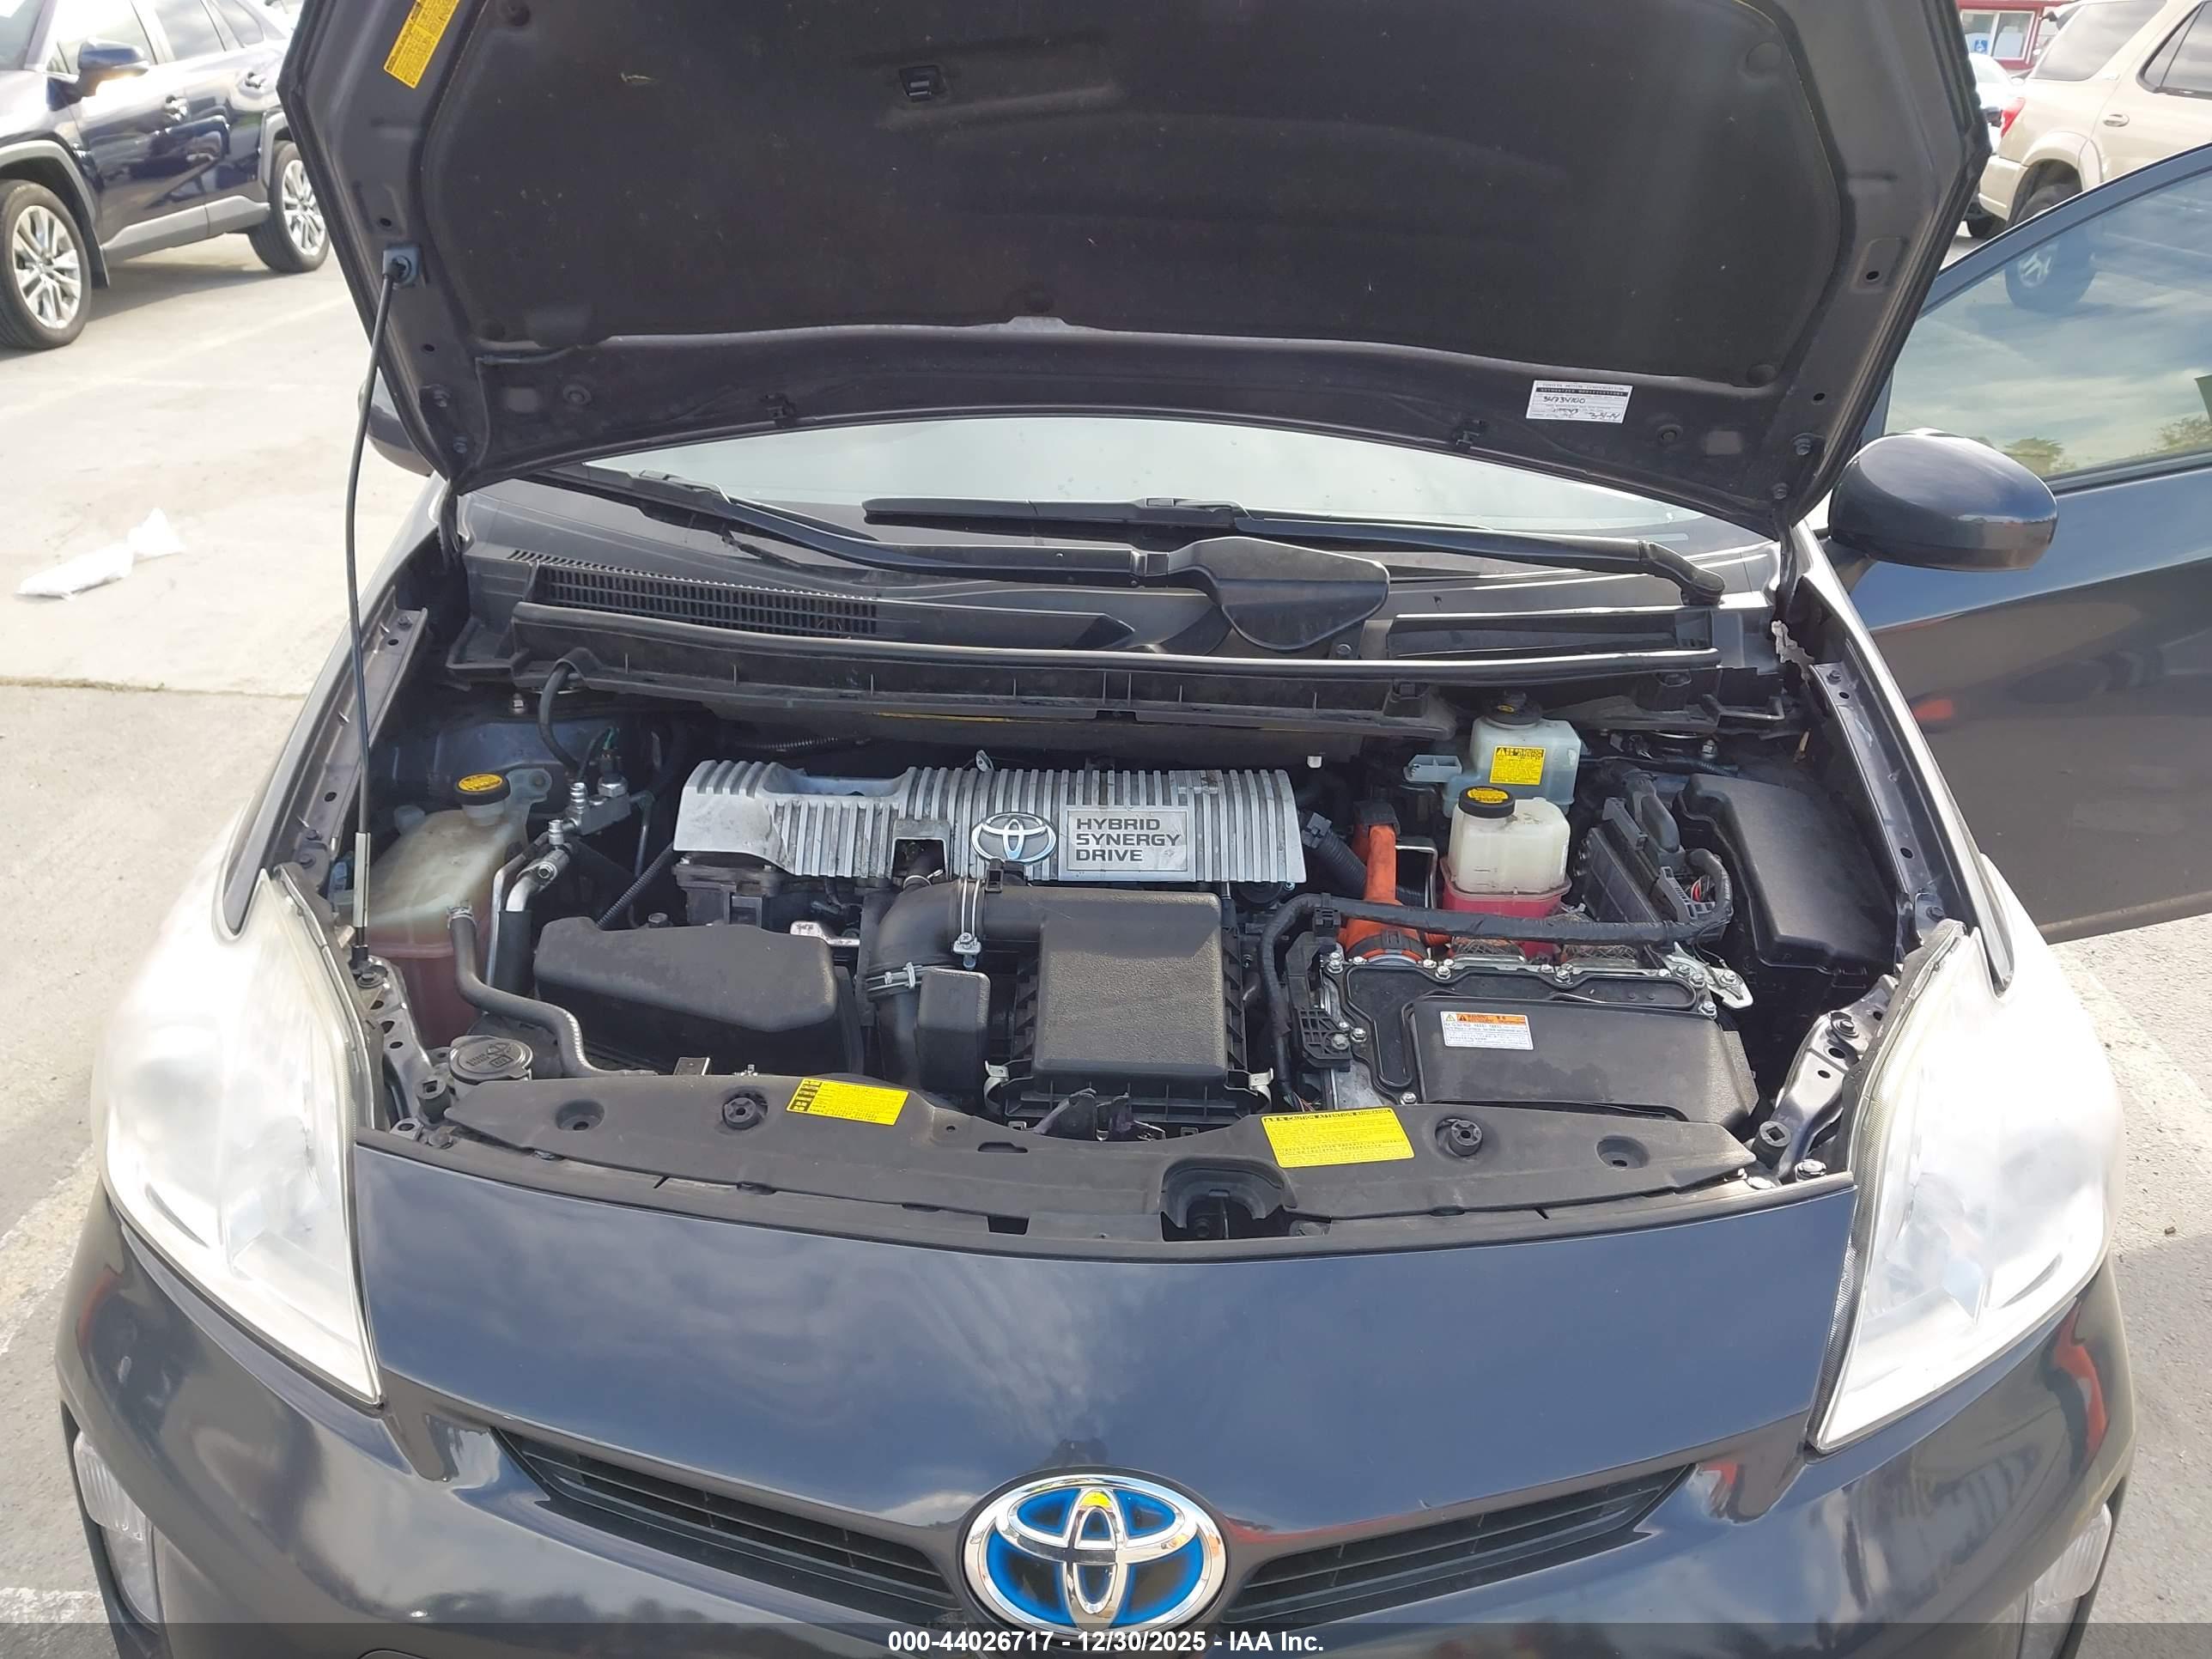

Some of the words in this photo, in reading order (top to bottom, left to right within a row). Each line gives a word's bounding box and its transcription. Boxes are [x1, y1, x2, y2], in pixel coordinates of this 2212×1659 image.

[1077, 818, 1160, 830] HYBRID
[1076, 833, 1181, 847] SYNERGY
[1076, 848, 1143, 861] DRIVE
